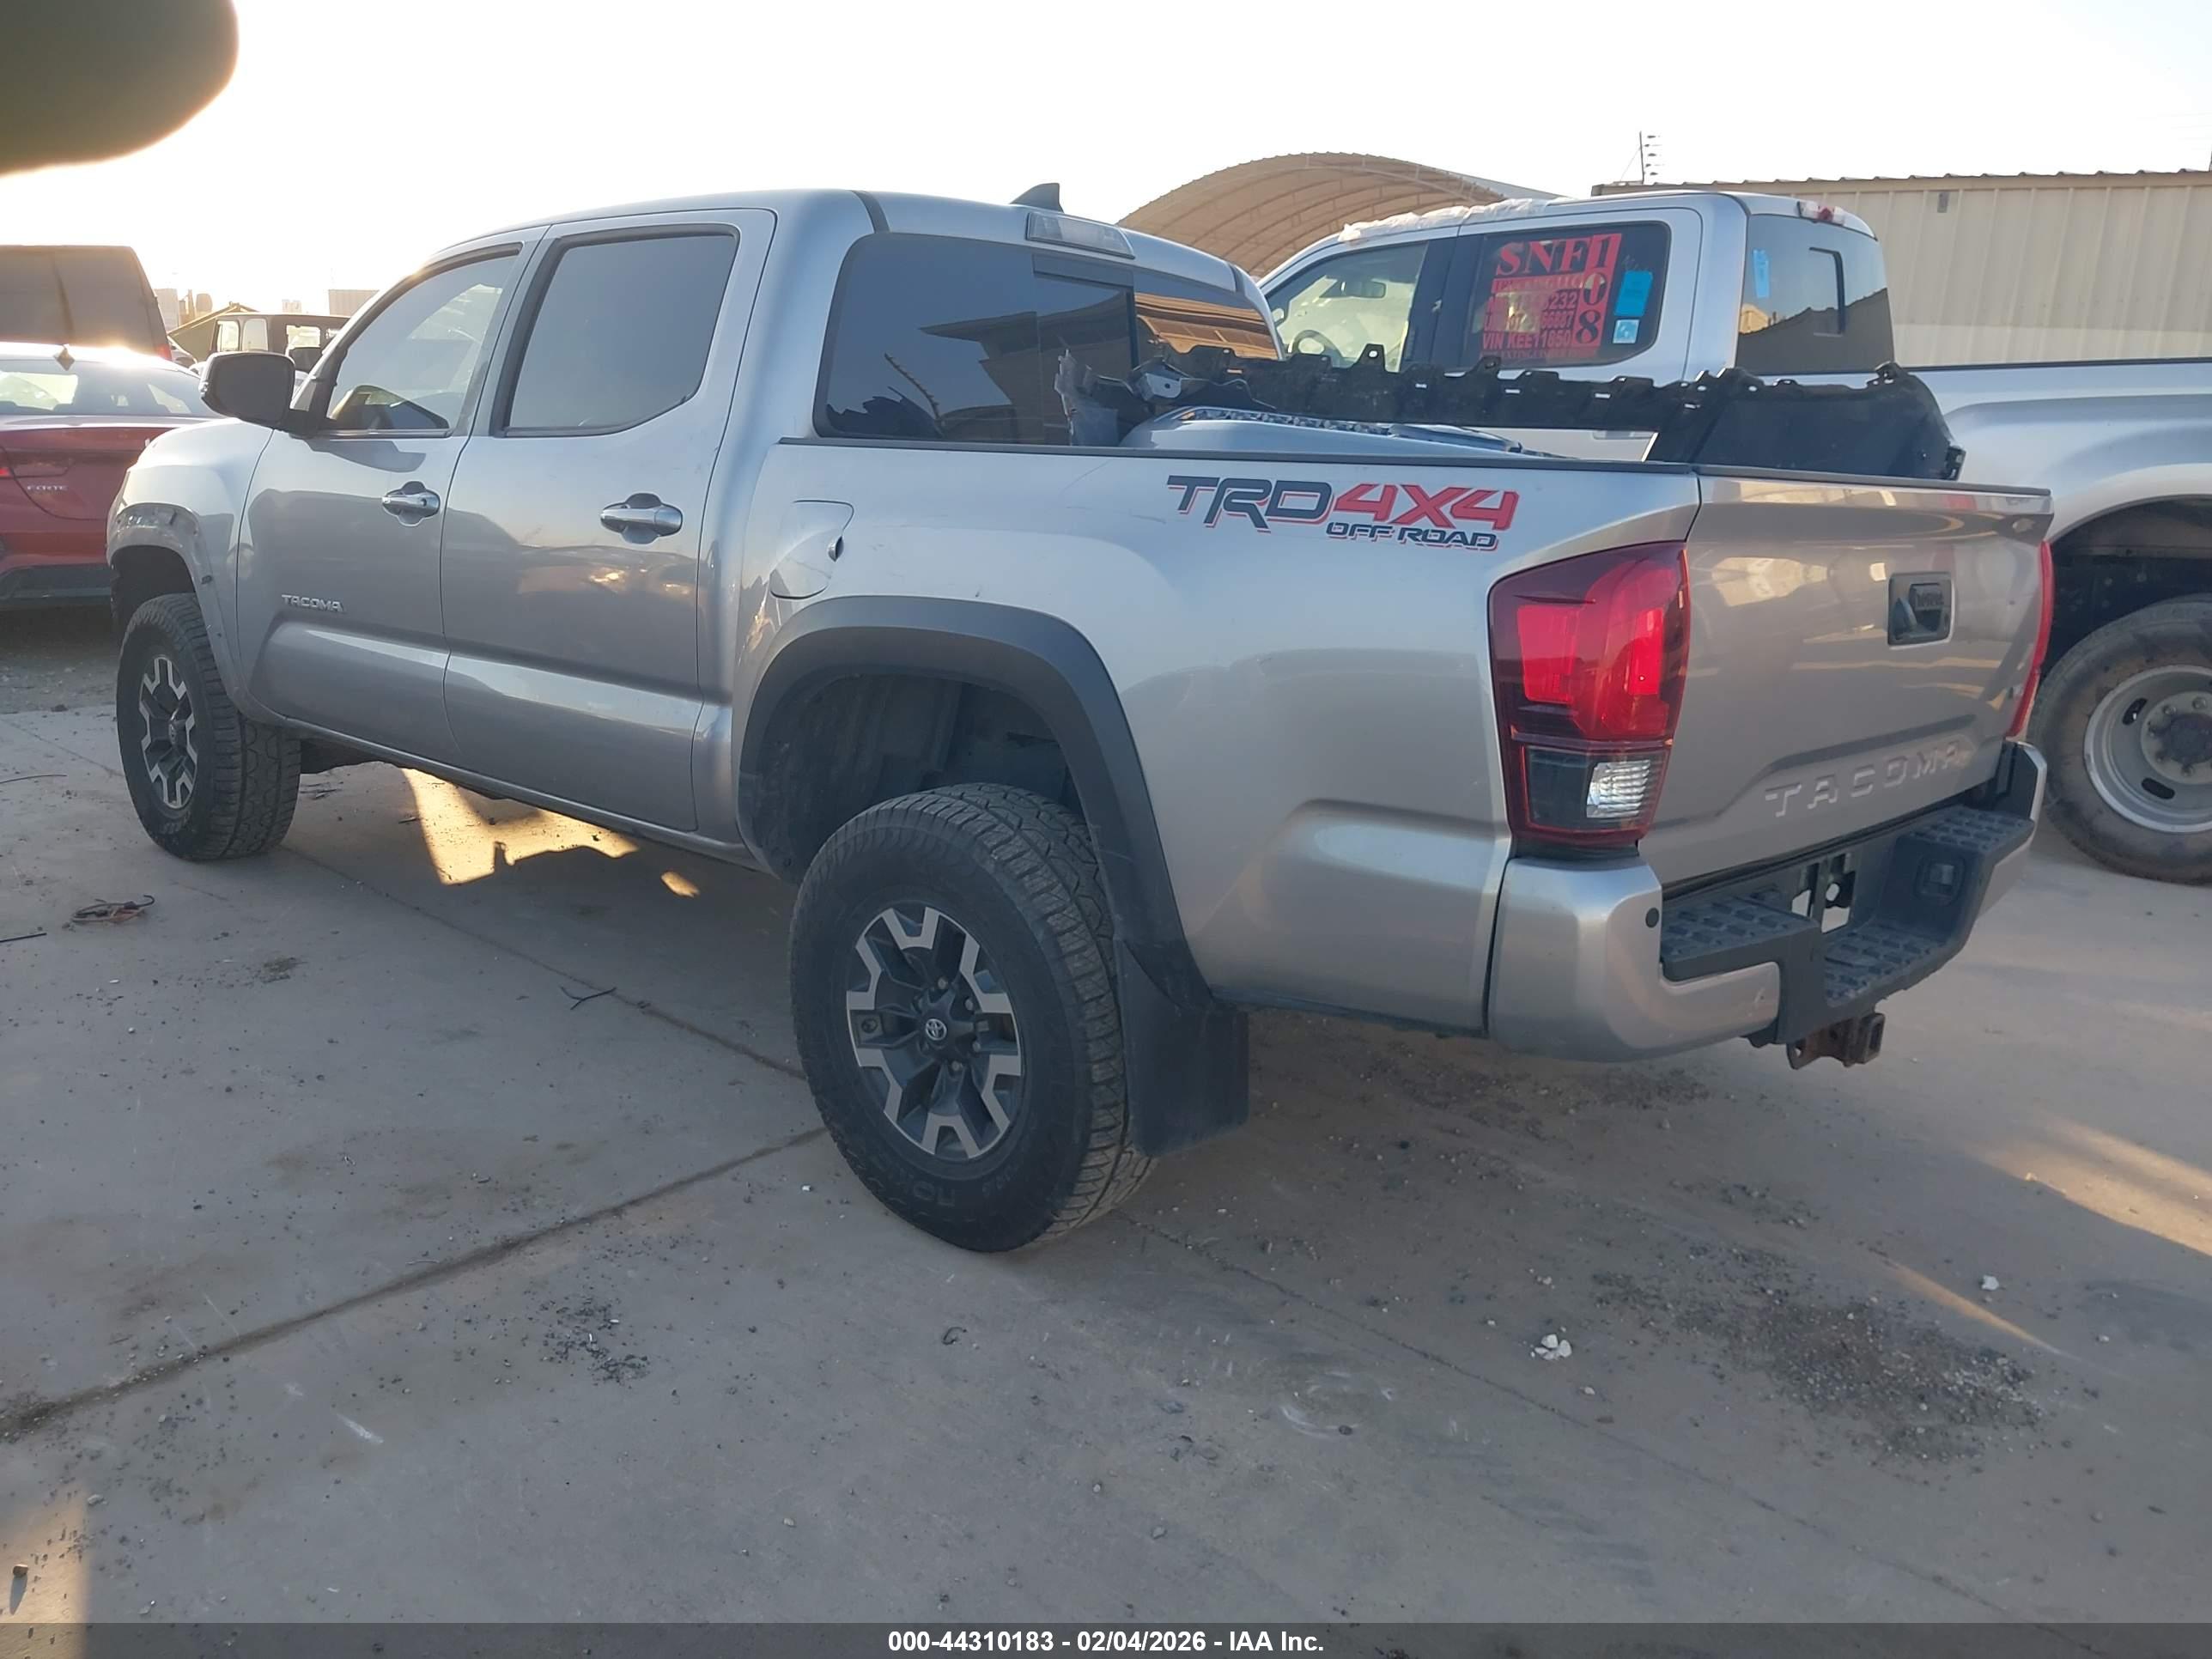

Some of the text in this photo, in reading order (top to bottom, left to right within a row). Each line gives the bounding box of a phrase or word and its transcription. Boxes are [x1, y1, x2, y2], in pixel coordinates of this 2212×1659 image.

[1496, 238, 1590, 276] SNF
[1483, 331, 1504, 349] VIN
[1167, 475, 1520, 532] TRD 4X4
[1326, 521, 1498, 550] OFF ROAD
[282, 593, 344, 612] TACOMA
[1765, 738, 1966, 817] TACOMA
